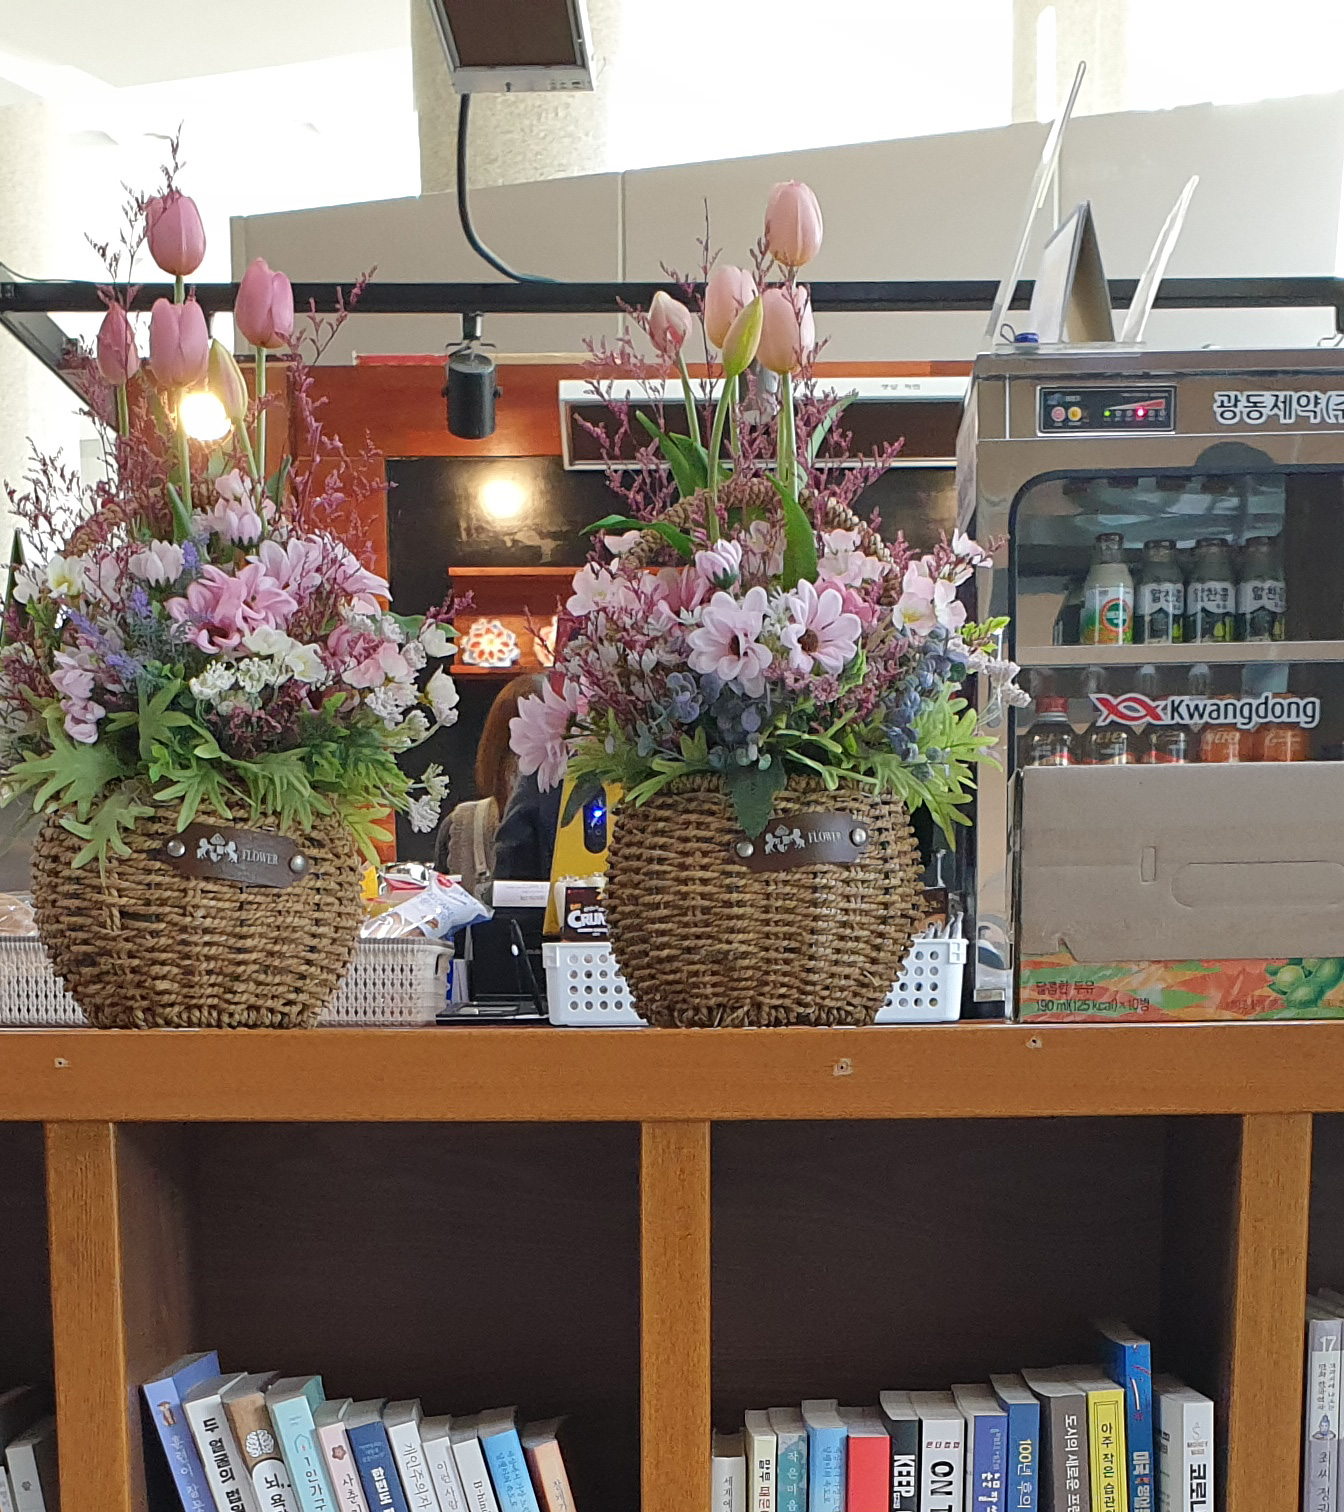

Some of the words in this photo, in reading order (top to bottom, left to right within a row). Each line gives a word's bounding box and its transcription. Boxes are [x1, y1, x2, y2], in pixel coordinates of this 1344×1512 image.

[1170, 694, 1317, 729] Kwangdong
[808, 827, 843, 845] FLOWER
[243, 849, 278, 865] FLOWER
[1065, 1415, 1078, 1451] 도시의
[371, 1466, 393, 1506] 한번도
[403, 1443, 432, 1510] 개인주의자
[893, 1455, 915, 1498] KEEP
[930, 1460, 954, 1496] ON
[1066, 1455, 1080, 1491] 새로운
